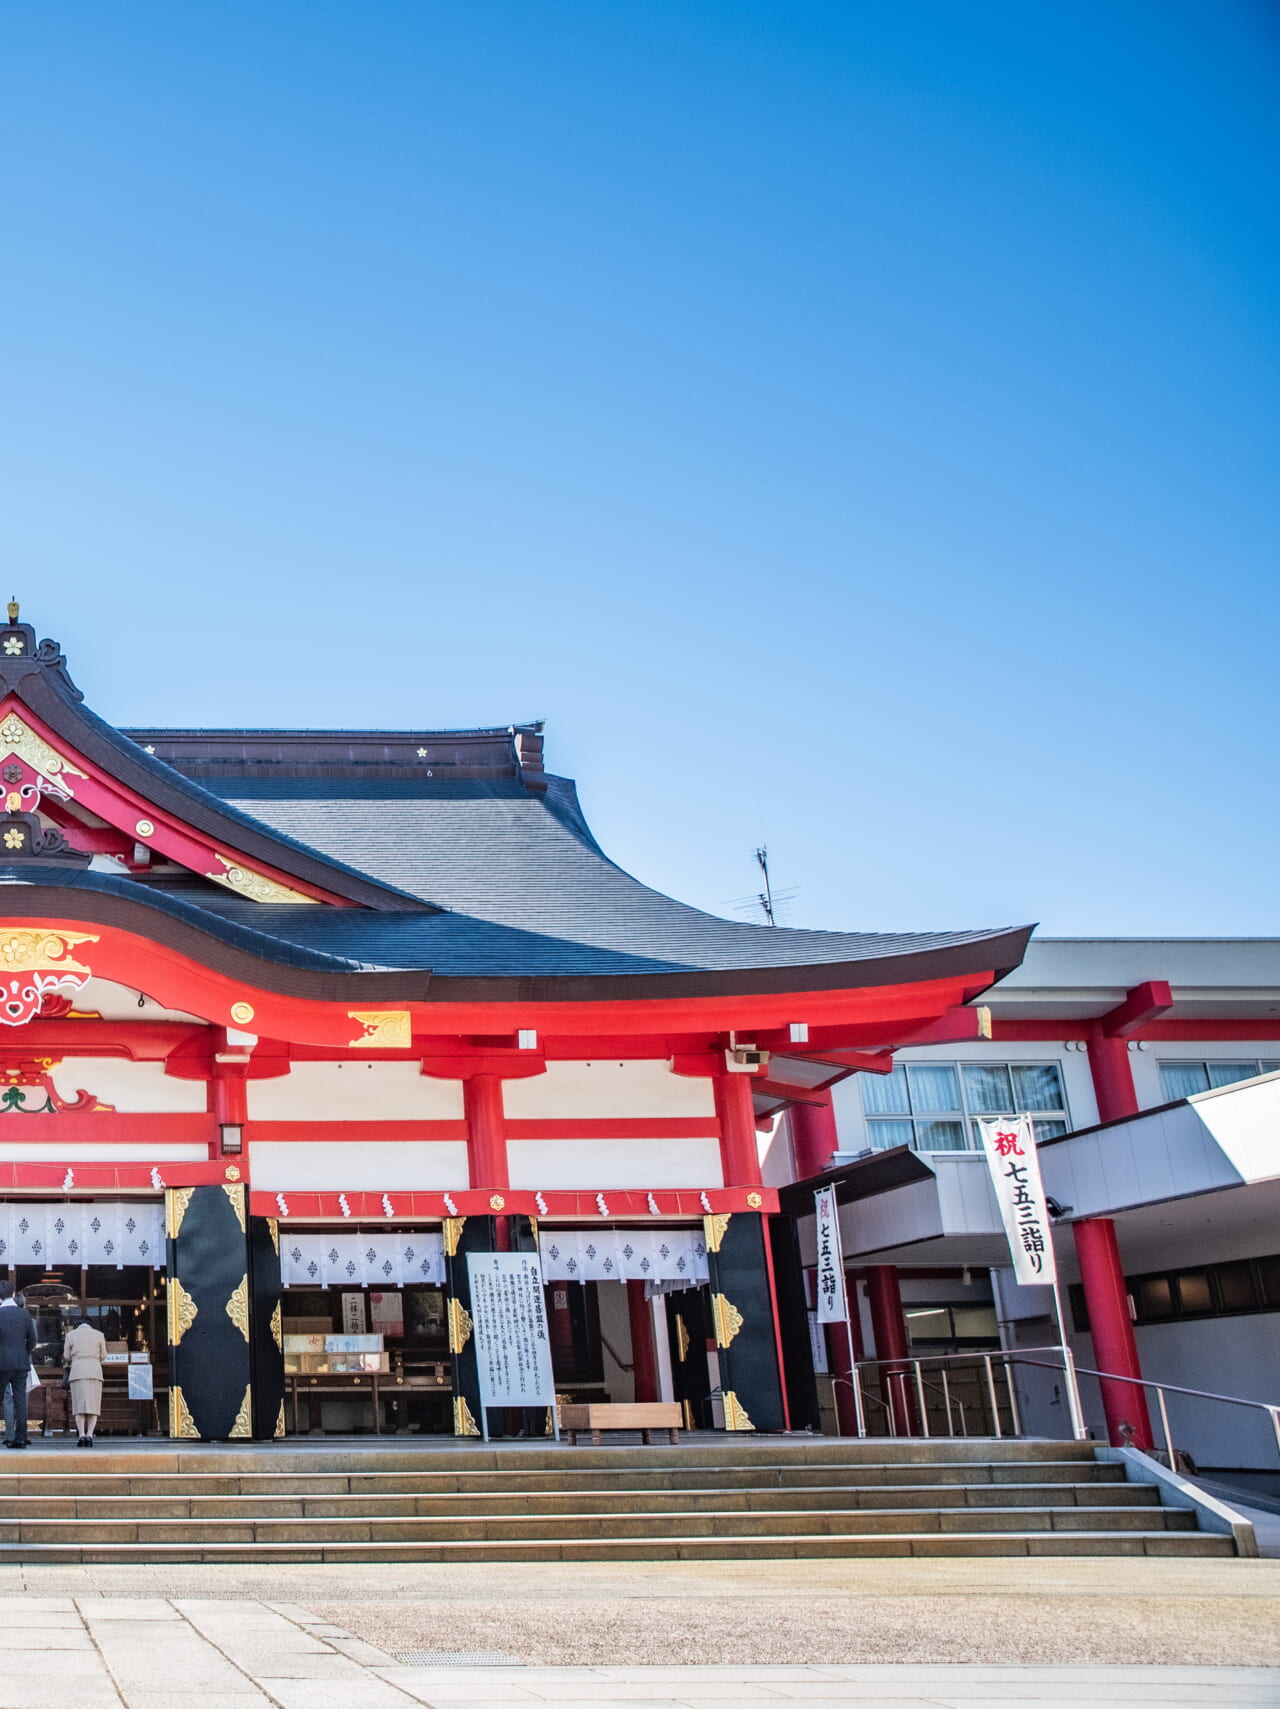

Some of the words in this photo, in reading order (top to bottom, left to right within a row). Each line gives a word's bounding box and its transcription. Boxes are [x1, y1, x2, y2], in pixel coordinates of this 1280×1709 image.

[993, 1132, 1025, 1157] 祝
[819, 1198, 830, 1220] 祝
[1004, 1161, 1044, 1274] 七五三詣り
[820, 1223, 837, 1311] 七五三詣り
